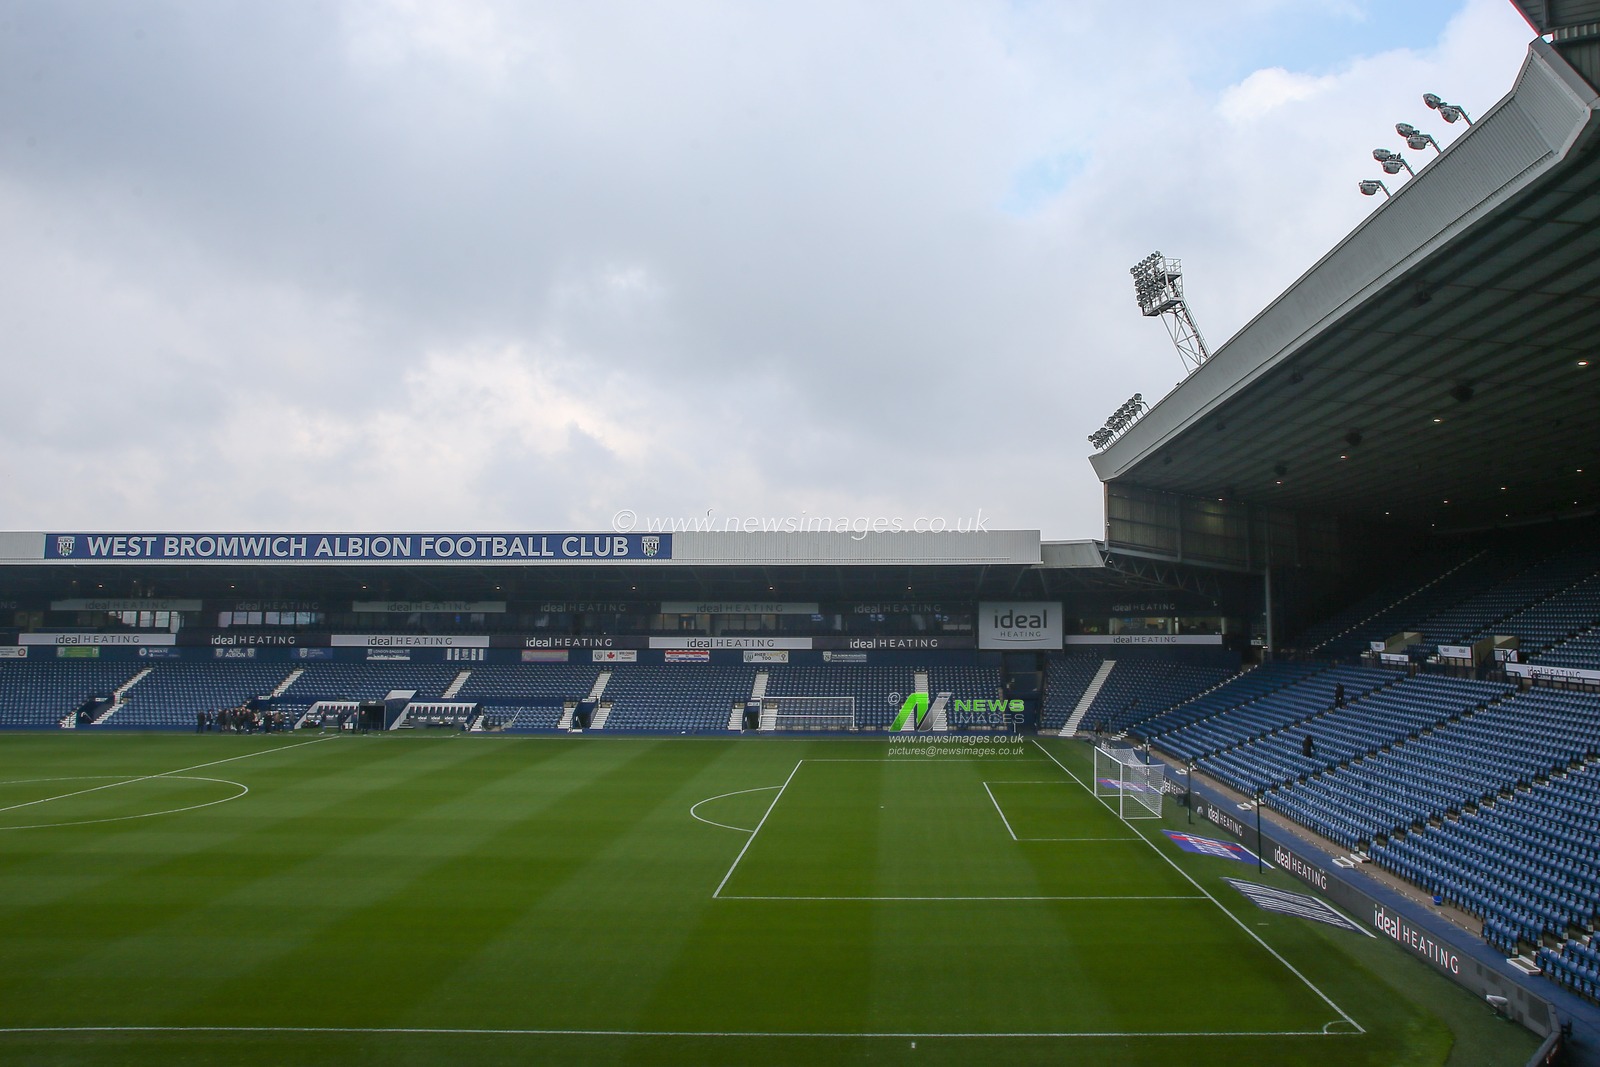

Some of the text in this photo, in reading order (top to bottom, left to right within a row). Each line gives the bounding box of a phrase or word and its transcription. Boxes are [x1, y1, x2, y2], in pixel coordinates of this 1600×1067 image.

[87, 536, 629, 557] WEST BROMWICH ALBION FOOTBALL CLUB
[993, 609, 1048, 629] ideal
[55, 634, 140, 644] ideal HEATING
[211, 635, 295, 645] ideal HEATING
[367, 636, 453, 646] ideal HEATING
[526, 637, 613, 647] ideal HEATING
[687, 638, 775, 648] ideal HEATING
[850, 638, 938, 648] ideal HEATING
[1113, 635, 1132, 643] ideal
[1207, 805, 1243, 837] ideal HEATING
[1274, 846, 1291, 870] ideal
[1292, 857, 1327, 890] HEATING
[1374, 904, 1400, 941] ideal
[1403, 924, 1459, 974] HEATING
